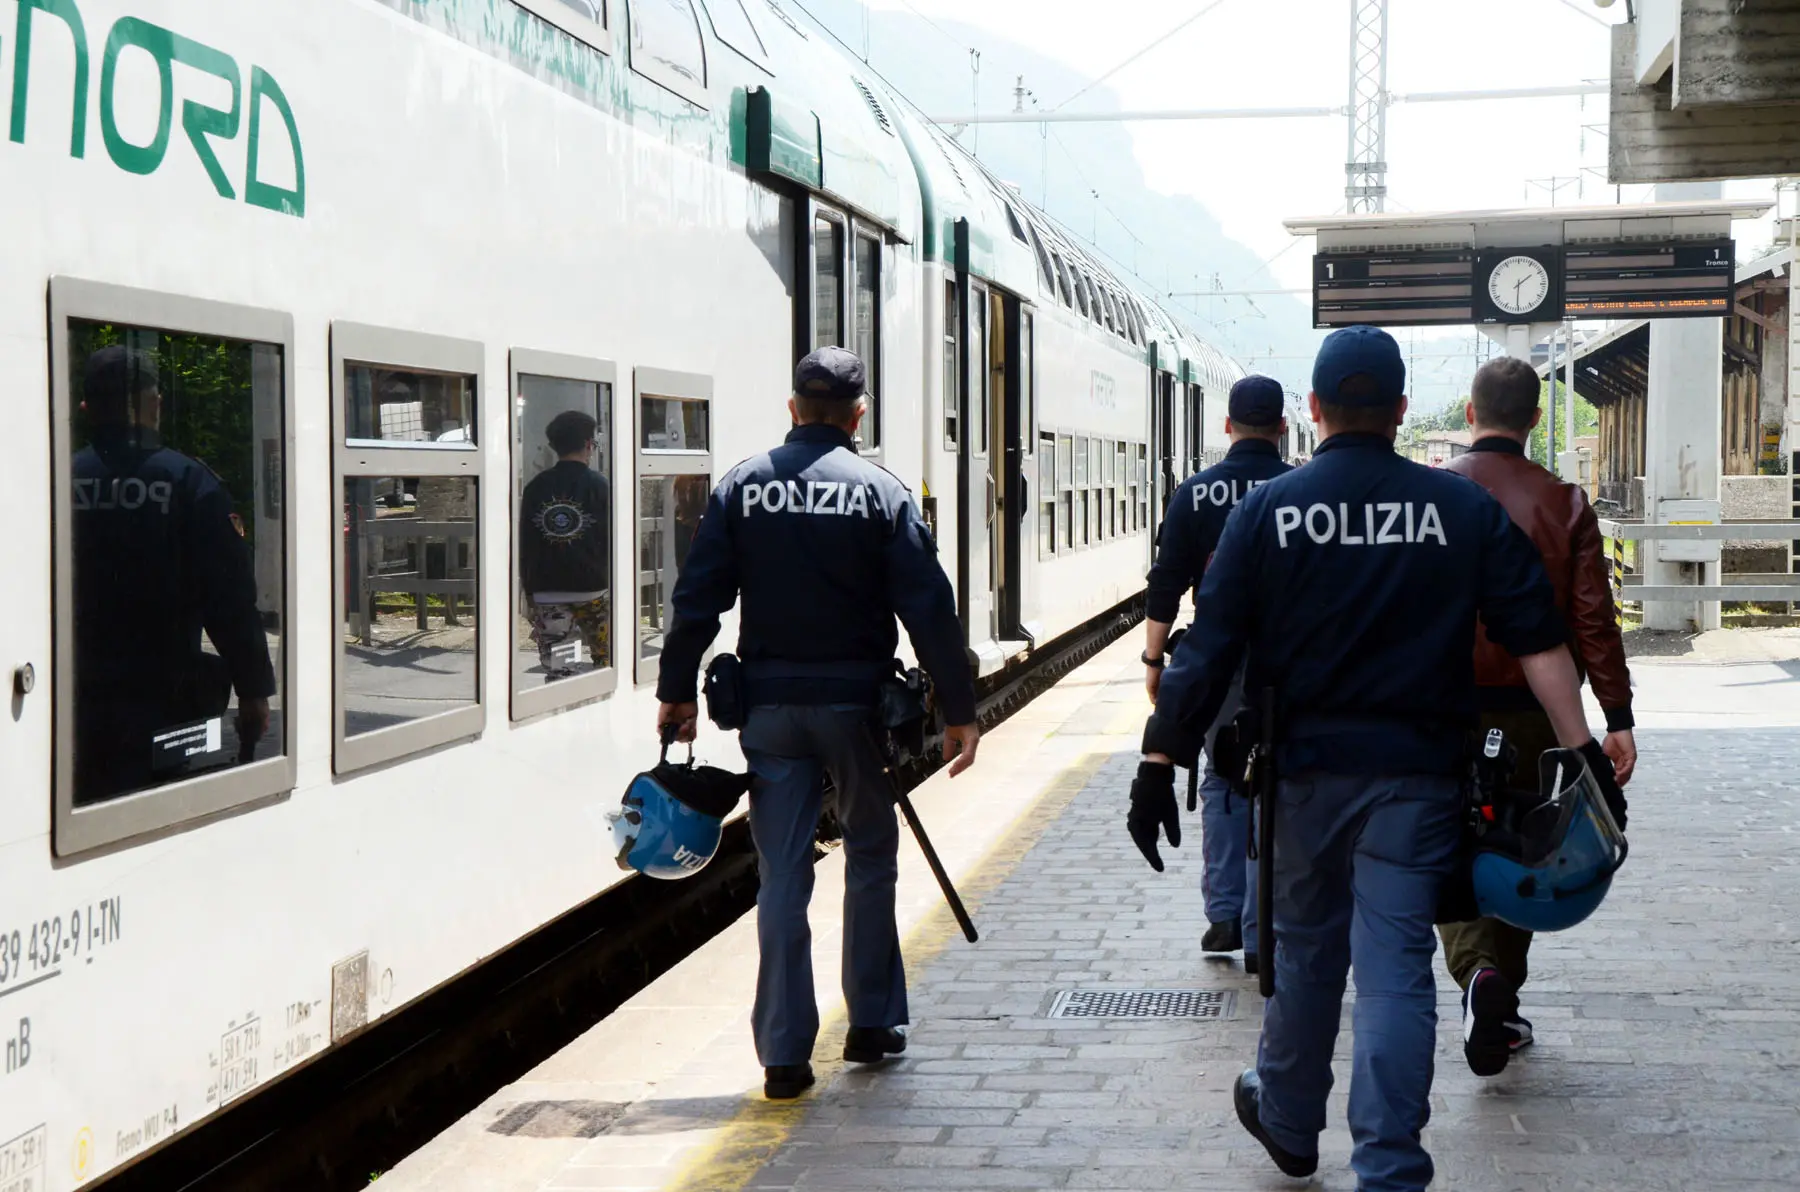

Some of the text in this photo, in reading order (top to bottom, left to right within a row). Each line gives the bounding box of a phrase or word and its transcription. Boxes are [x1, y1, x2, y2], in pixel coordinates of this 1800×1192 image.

[1325, 262, 1334, 279] 1
[1704, 259, 1729, 267] Tronco
[1713, 248, 1720, 260] 1
[742, 479, 870, 519] POLIZIA
[1191, 479, 1269, 512] POLI
[1275, 502, 1448, 549] POLIZIA
[28, 908, 81, 971] 432-9
[6, 1016, 31, 1074] nB
